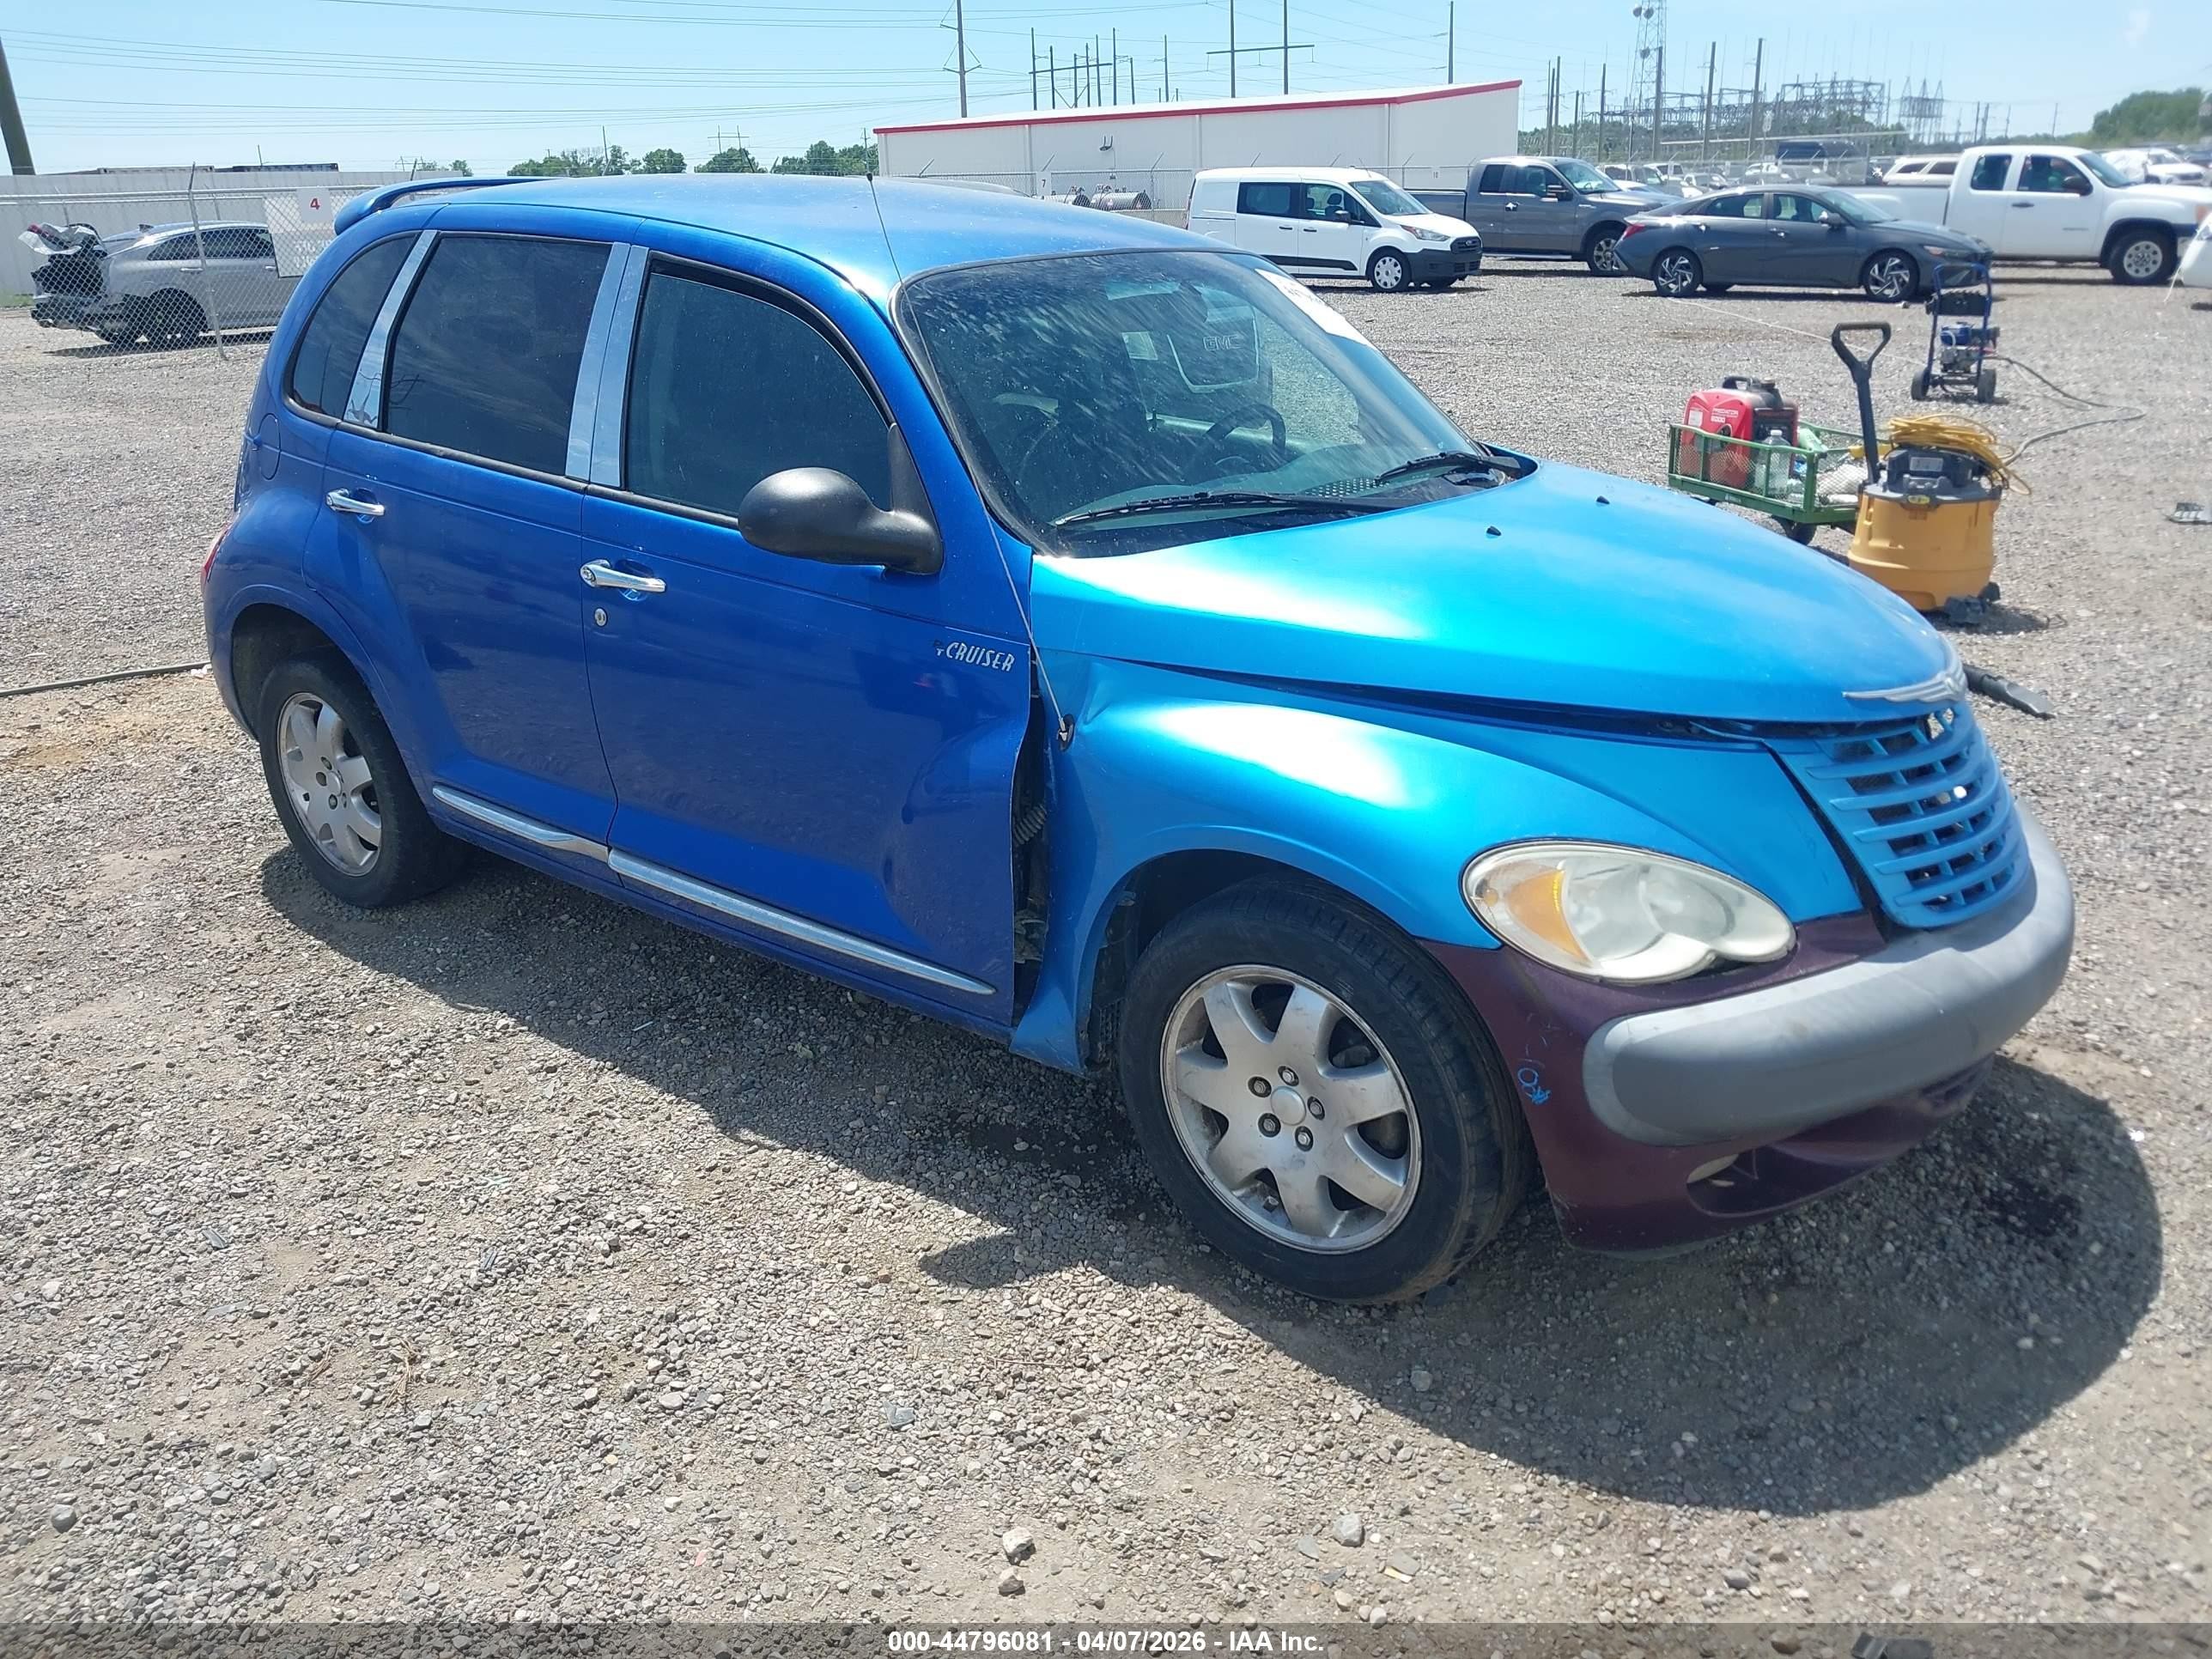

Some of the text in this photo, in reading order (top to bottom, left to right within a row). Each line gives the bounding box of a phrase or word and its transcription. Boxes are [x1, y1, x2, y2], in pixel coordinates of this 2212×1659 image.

[1042, 179, 1047, 188] 7
[310, 197, 321, 210] 4
[1203, 335, 1243, 351] GMC
[945, 641, 1015, 672] CRUISER
